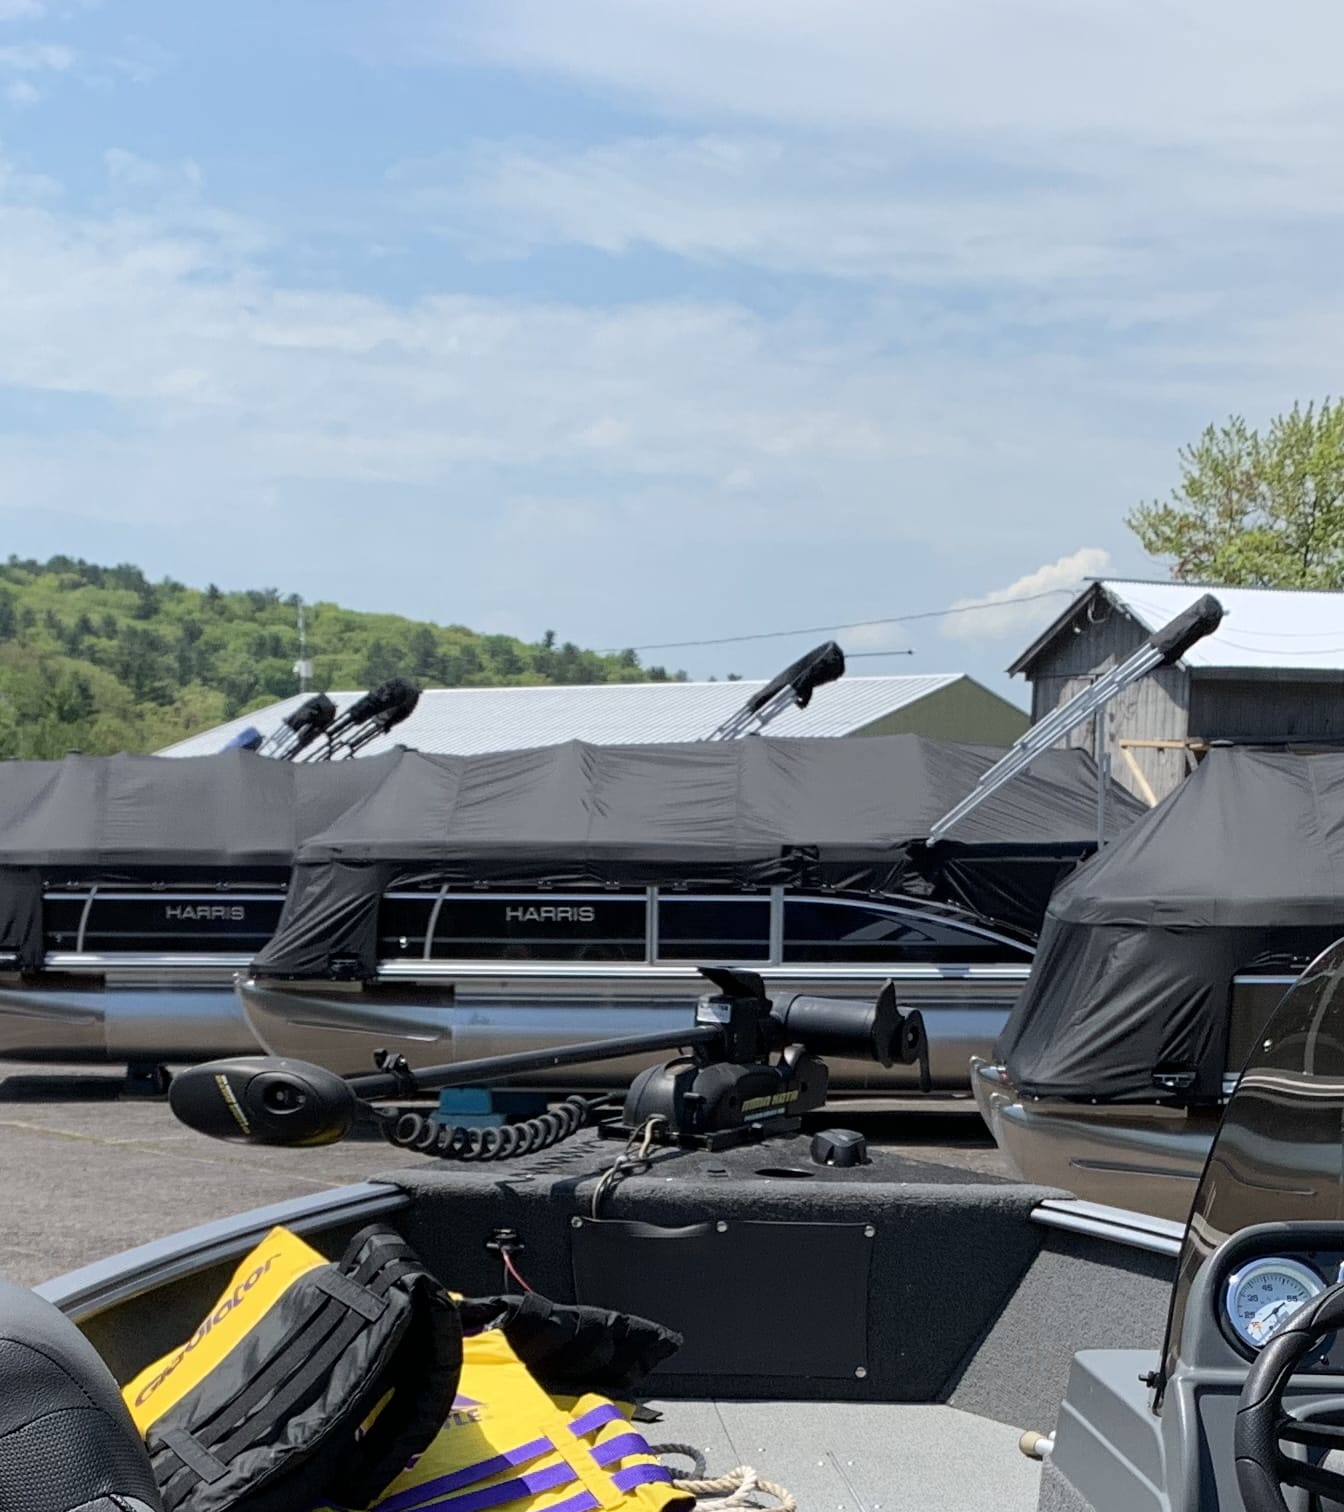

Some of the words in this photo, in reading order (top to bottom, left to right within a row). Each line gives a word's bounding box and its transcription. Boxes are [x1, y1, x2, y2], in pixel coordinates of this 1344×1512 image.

[165, 904, 245, 920] HARRIS
[505, 906, 595, 921] HARRIS
[1262, 1284, 1273, 1292] 45
